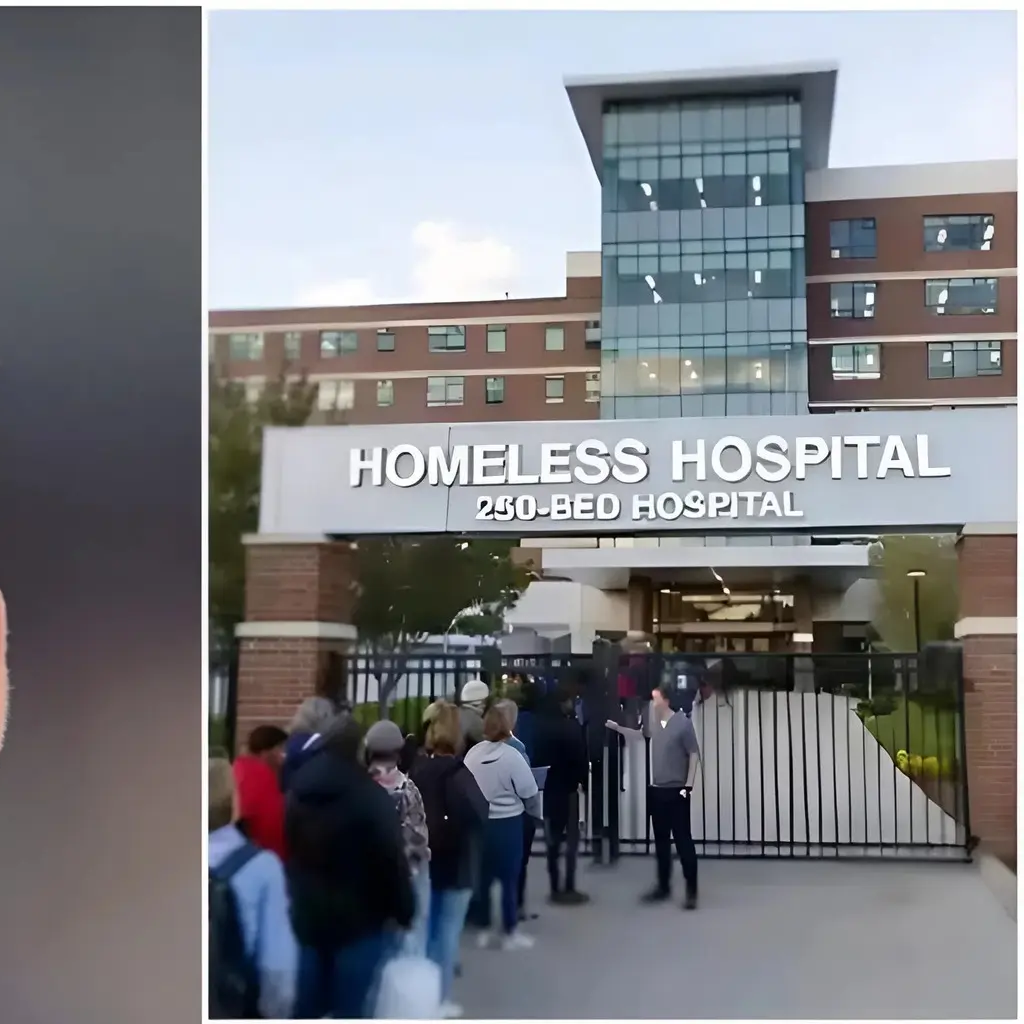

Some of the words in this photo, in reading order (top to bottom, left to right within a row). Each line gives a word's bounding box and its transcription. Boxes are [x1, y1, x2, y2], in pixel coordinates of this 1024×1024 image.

[350, 438, 649, 487] HOMELESS
[671, 434, 951, 482] HOSPITAL
[632, 490, 804, 519] HOSPITAL
